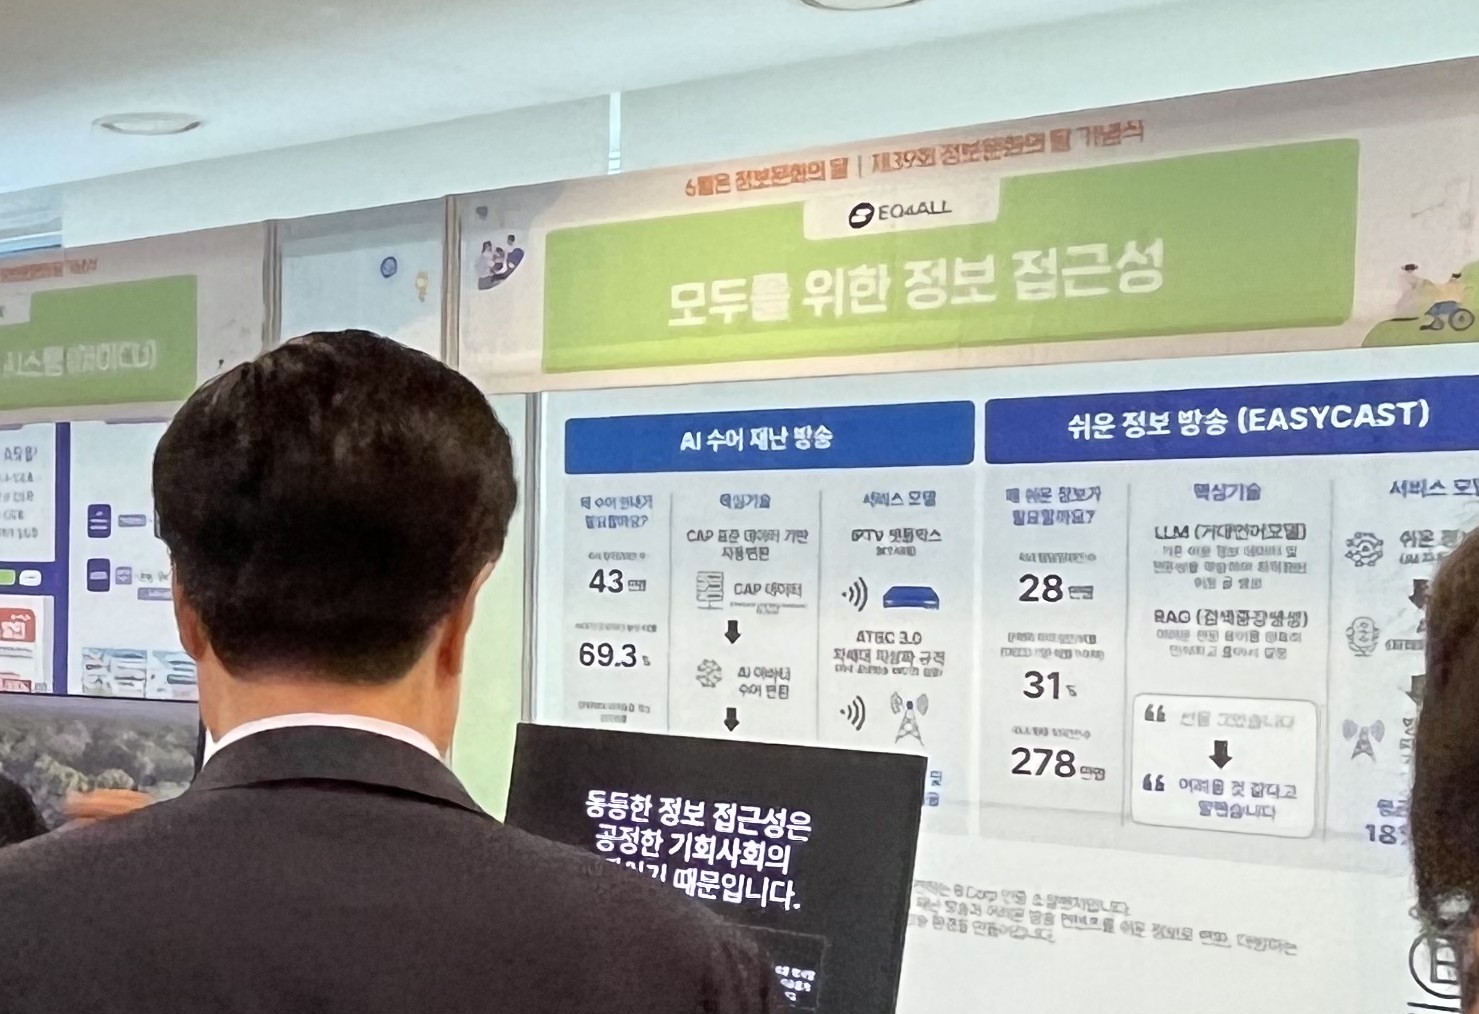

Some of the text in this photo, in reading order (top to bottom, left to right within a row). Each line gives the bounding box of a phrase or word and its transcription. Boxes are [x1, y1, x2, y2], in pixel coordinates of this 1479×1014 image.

[668, 237, 1165, 327] 모두를 위한 정보 접근성
[1067, 398, 1430, 440] 쉬운 정보 방송 (EASYCAST)
[680, 424, 834, 453] AI 수어 재난 방송
[1389, 480, 1447, 498] 서비스
[1154, 525, 1190, 540] LLM
[588, 568, 624, 594] 43
[733, 583, 762, 597] CAP
[1018, 573, 1064, 603] 28
[578, 642, 638, 668] 69.3
[1023, 670, 1061, 700] 31
[1011, 746, 1077, 778] 278
[585, 789, 813, 842] 동등한 정보 접근성은
[595, 823, 665, 858] 공정한
[669, 832, 792, 876] 기회사회의
[673, 867, 802, 911] 때문입니다.
